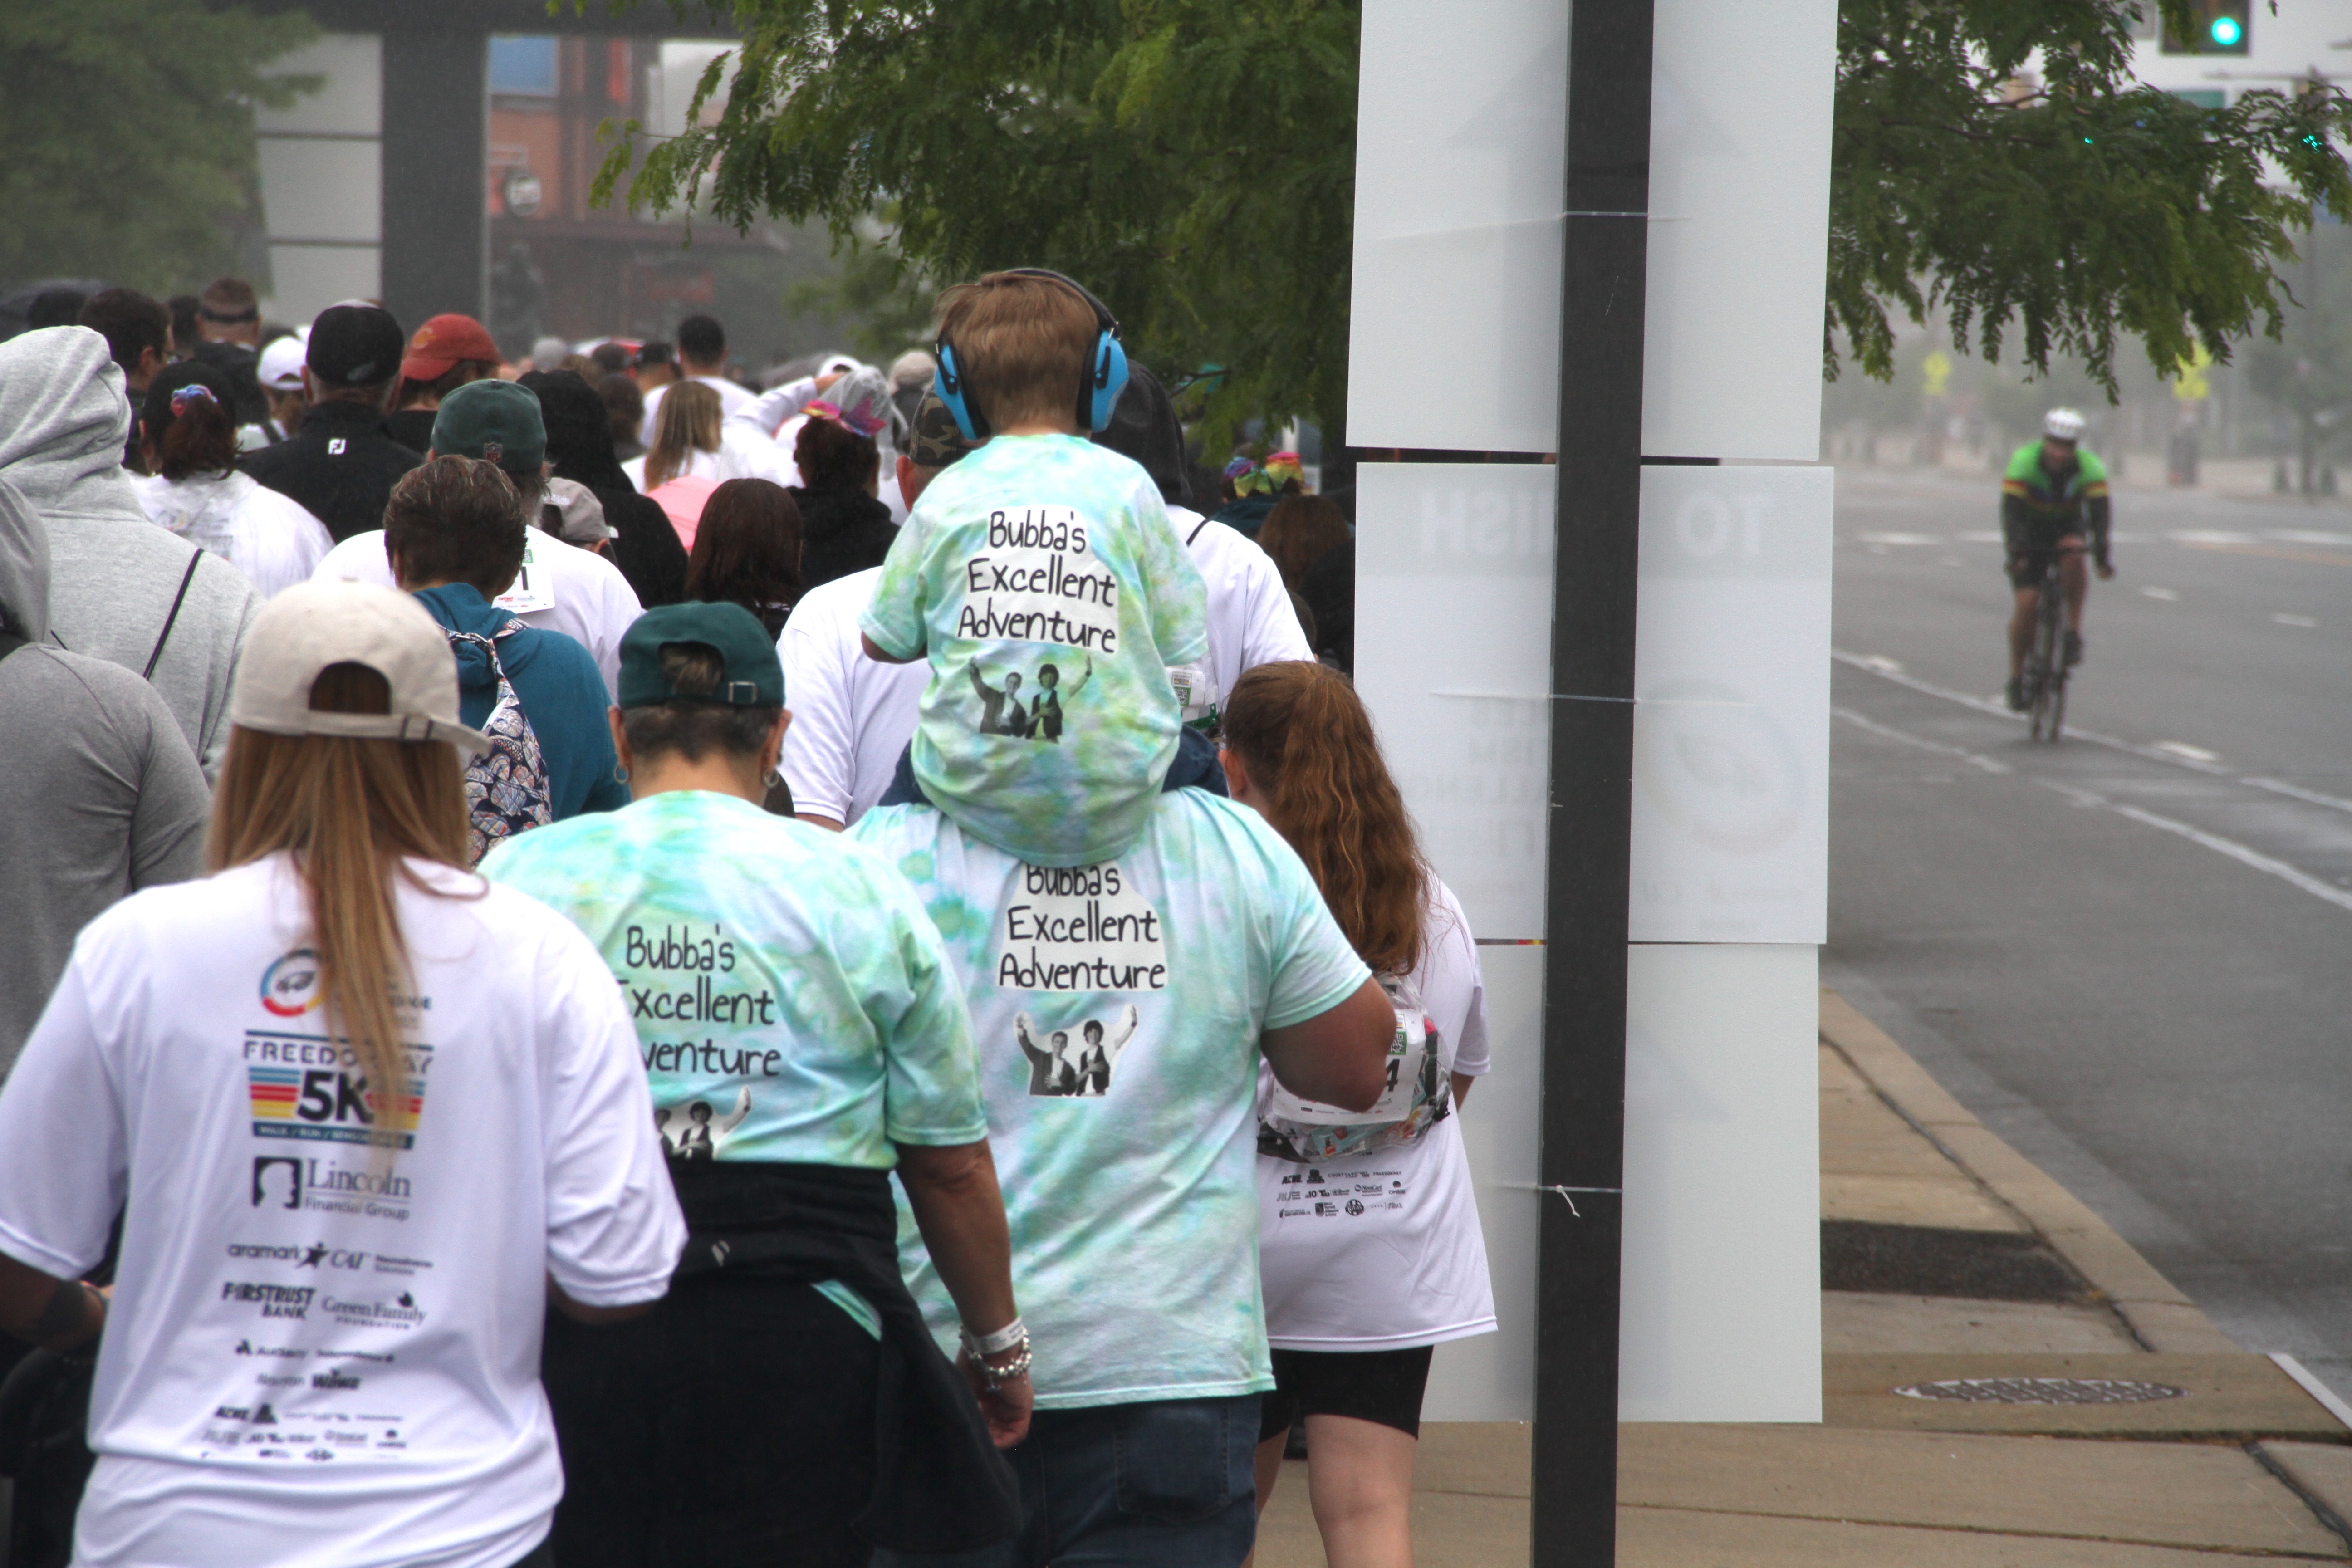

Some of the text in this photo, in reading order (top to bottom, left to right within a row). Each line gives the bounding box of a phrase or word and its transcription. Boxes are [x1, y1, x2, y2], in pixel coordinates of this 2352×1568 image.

[328, 438, 347, 455] FJ
[989, 509, 1086, 554] Bubba's
[968, 554, 1116, 607] Excellent
[958, 597, 1116, 653] Adventure
[1026, 863, 1121, 897] Bubbas
[1007, 900, 1159, 943] Excellent
[626, 923, 735, 972] Bubba's
[999, 946, 1165, 990] Adventure
[617, 975, 775, 1025] xcellent
[644, 1039, 781, 1076] venture
[297, 1069, 374, 1124] 5K
[307, 1158, 411, 1197] Lincoln
[305, 1196, 411, 1221] Financial Group
